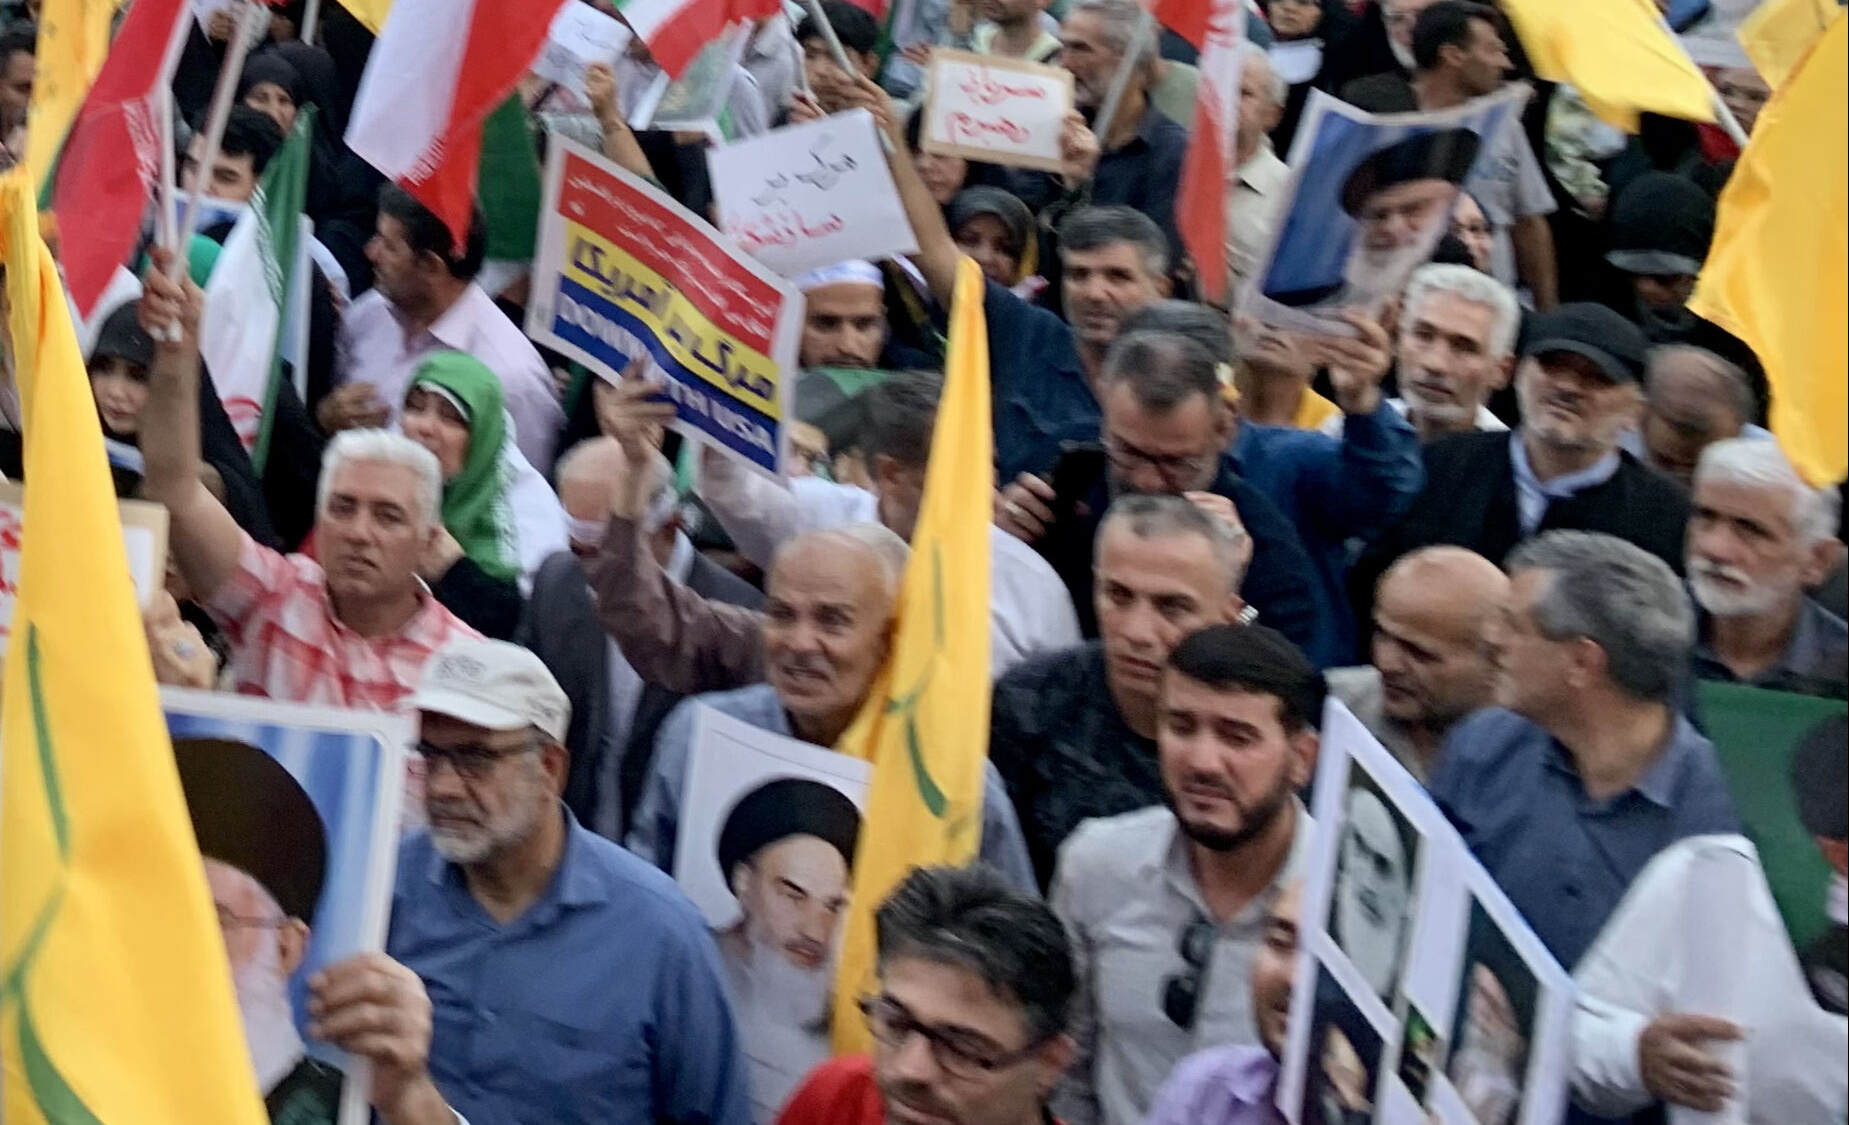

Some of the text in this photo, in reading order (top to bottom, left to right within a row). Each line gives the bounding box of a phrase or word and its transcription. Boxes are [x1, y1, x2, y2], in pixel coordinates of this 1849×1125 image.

[572, 237, 674, 321] آمریکا
[692, 339, 776, 401] مرگ
[715, 400, 777, 459] USA
